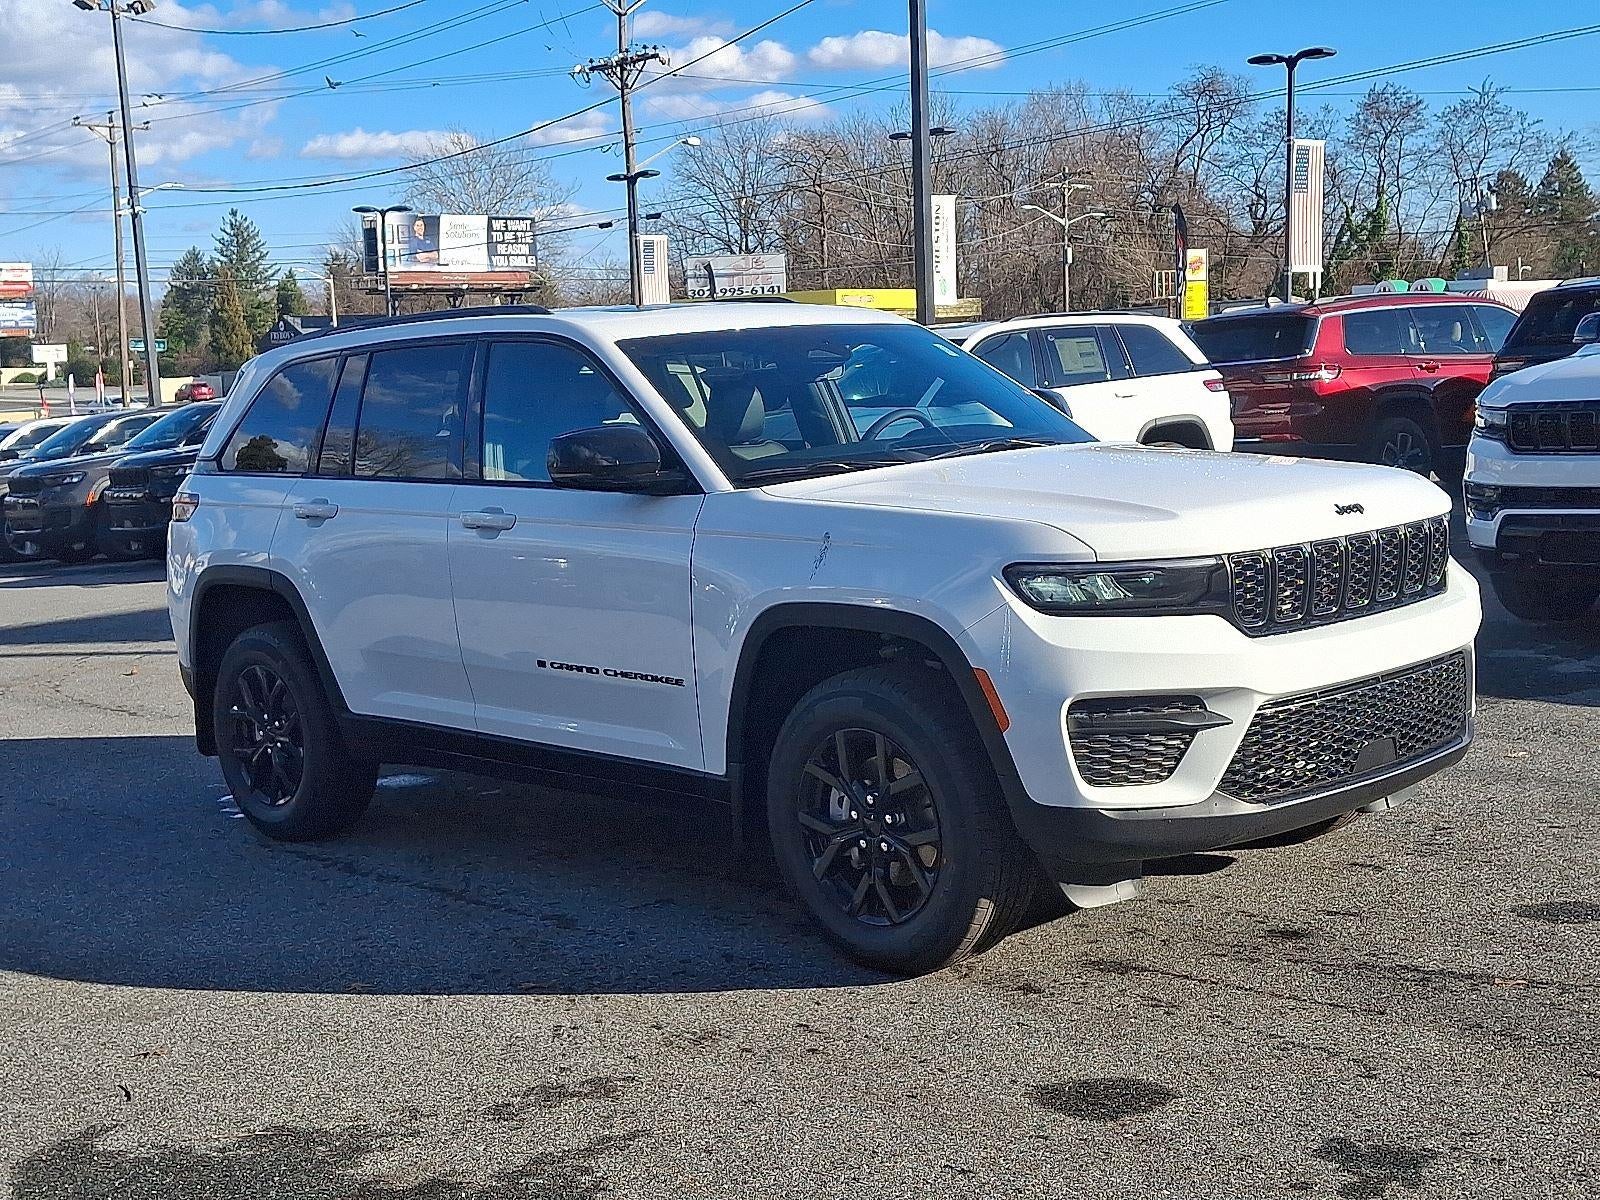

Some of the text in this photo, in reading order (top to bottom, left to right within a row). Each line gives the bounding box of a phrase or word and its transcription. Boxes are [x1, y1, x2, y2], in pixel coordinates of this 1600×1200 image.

[491, 219, 532, 231] WE WANT
[491, 231, 534, 243] TO BE THE
[497, 243, 530, 255] REASON
[491, 255, 508, 266] YOU
[1333, 503, 1365, 516] Jeep
[549, 661, 685, 687] GRAND CHEROKEE
